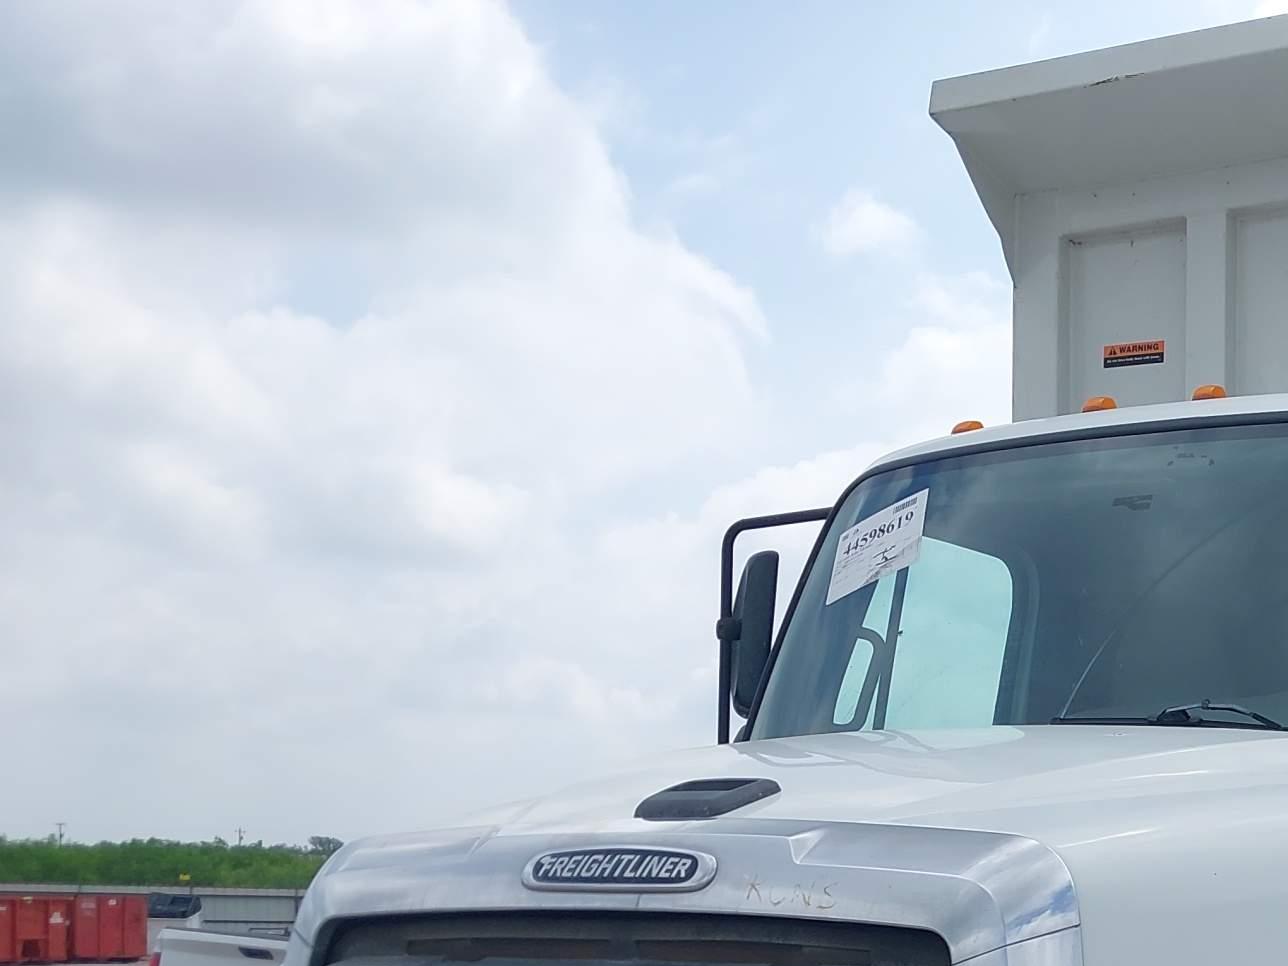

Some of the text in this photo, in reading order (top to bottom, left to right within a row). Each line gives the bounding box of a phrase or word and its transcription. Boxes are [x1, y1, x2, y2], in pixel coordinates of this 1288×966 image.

[1119, 343, 1159, 353] WARNING
[842, 510, 914, 556] 44598619
[538, 853, 692, 879] FREIGHTLINER
